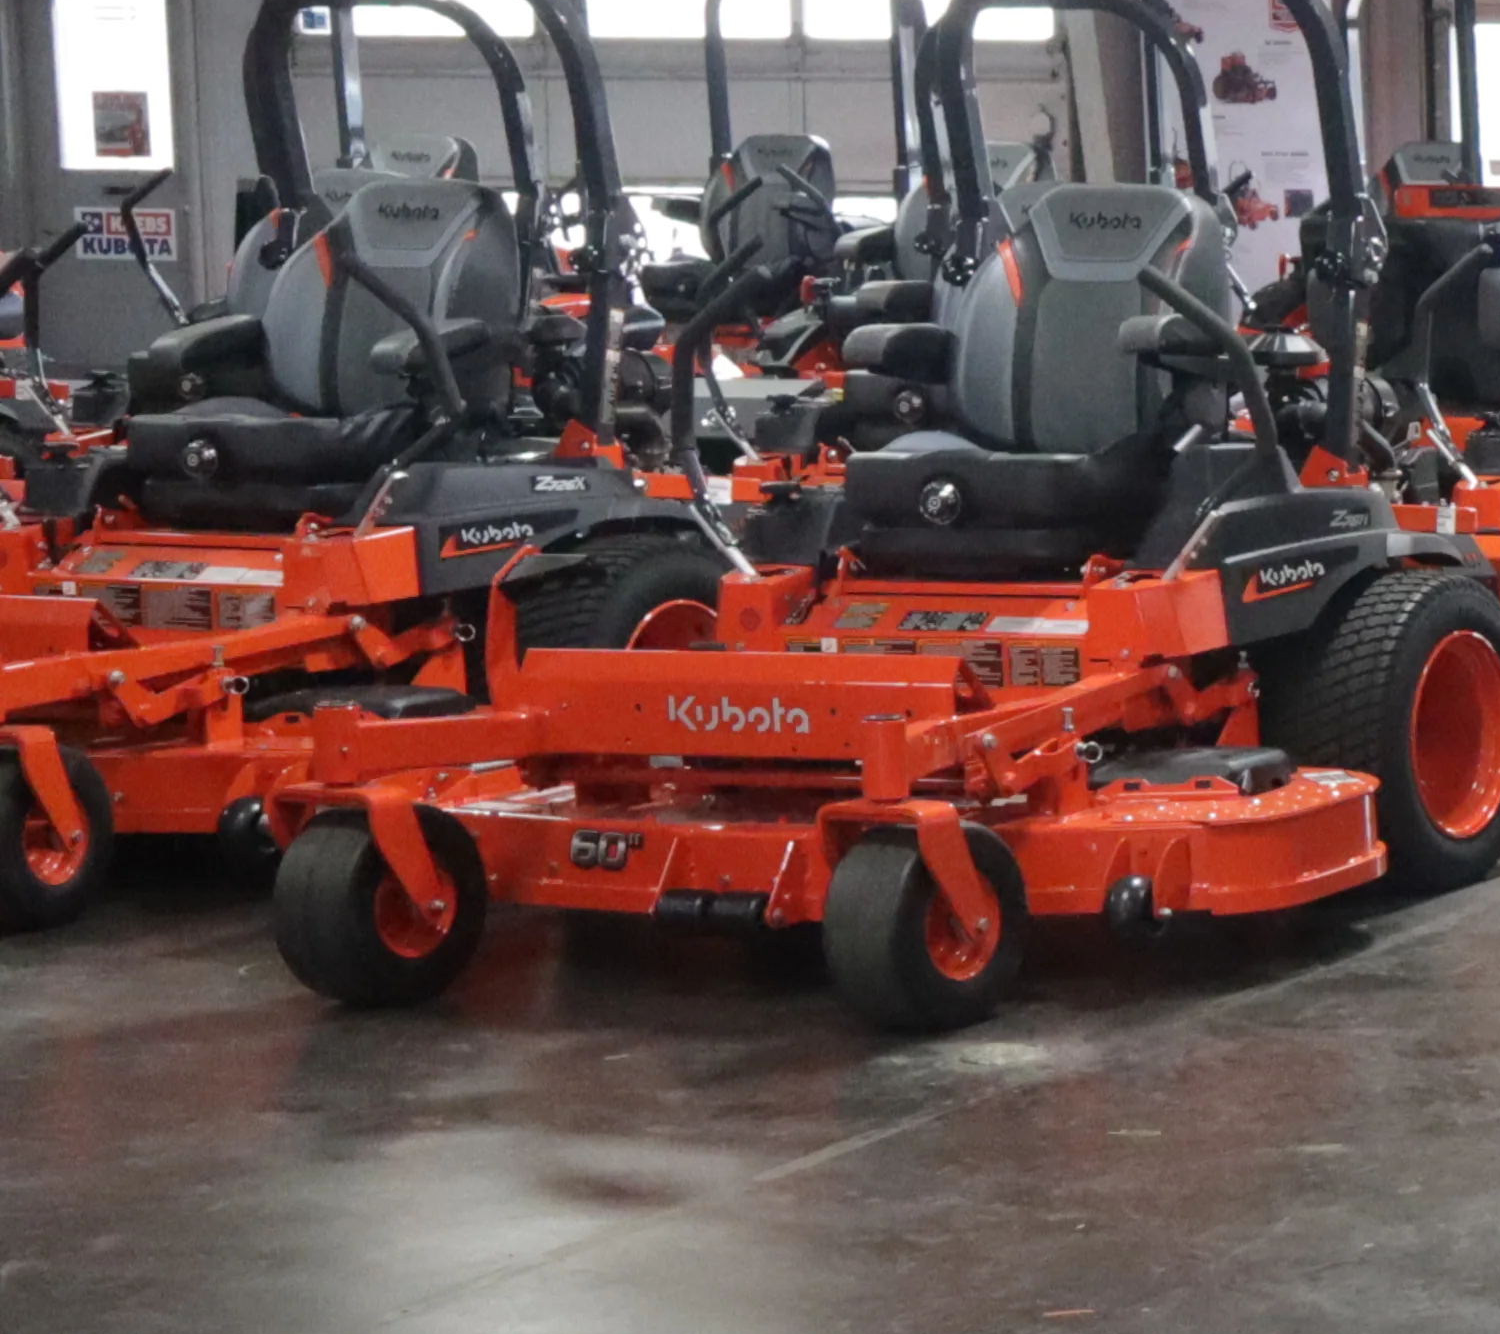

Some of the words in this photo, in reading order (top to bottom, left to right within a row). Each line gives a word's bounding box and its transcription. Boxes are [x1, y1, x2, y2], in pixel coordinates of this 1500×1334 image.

[377, 201, 440, 221] Kubota
[110, 216, 168, 233] KEBS
[1069, 212, 1142, 231] Kubota
[82, 236, 173, 256] KUBTA
[462, 522, 534, 545] Kubota
[1259, 561, 1325, 585] Kubota
[668, 695, 811, 734] Kubota
